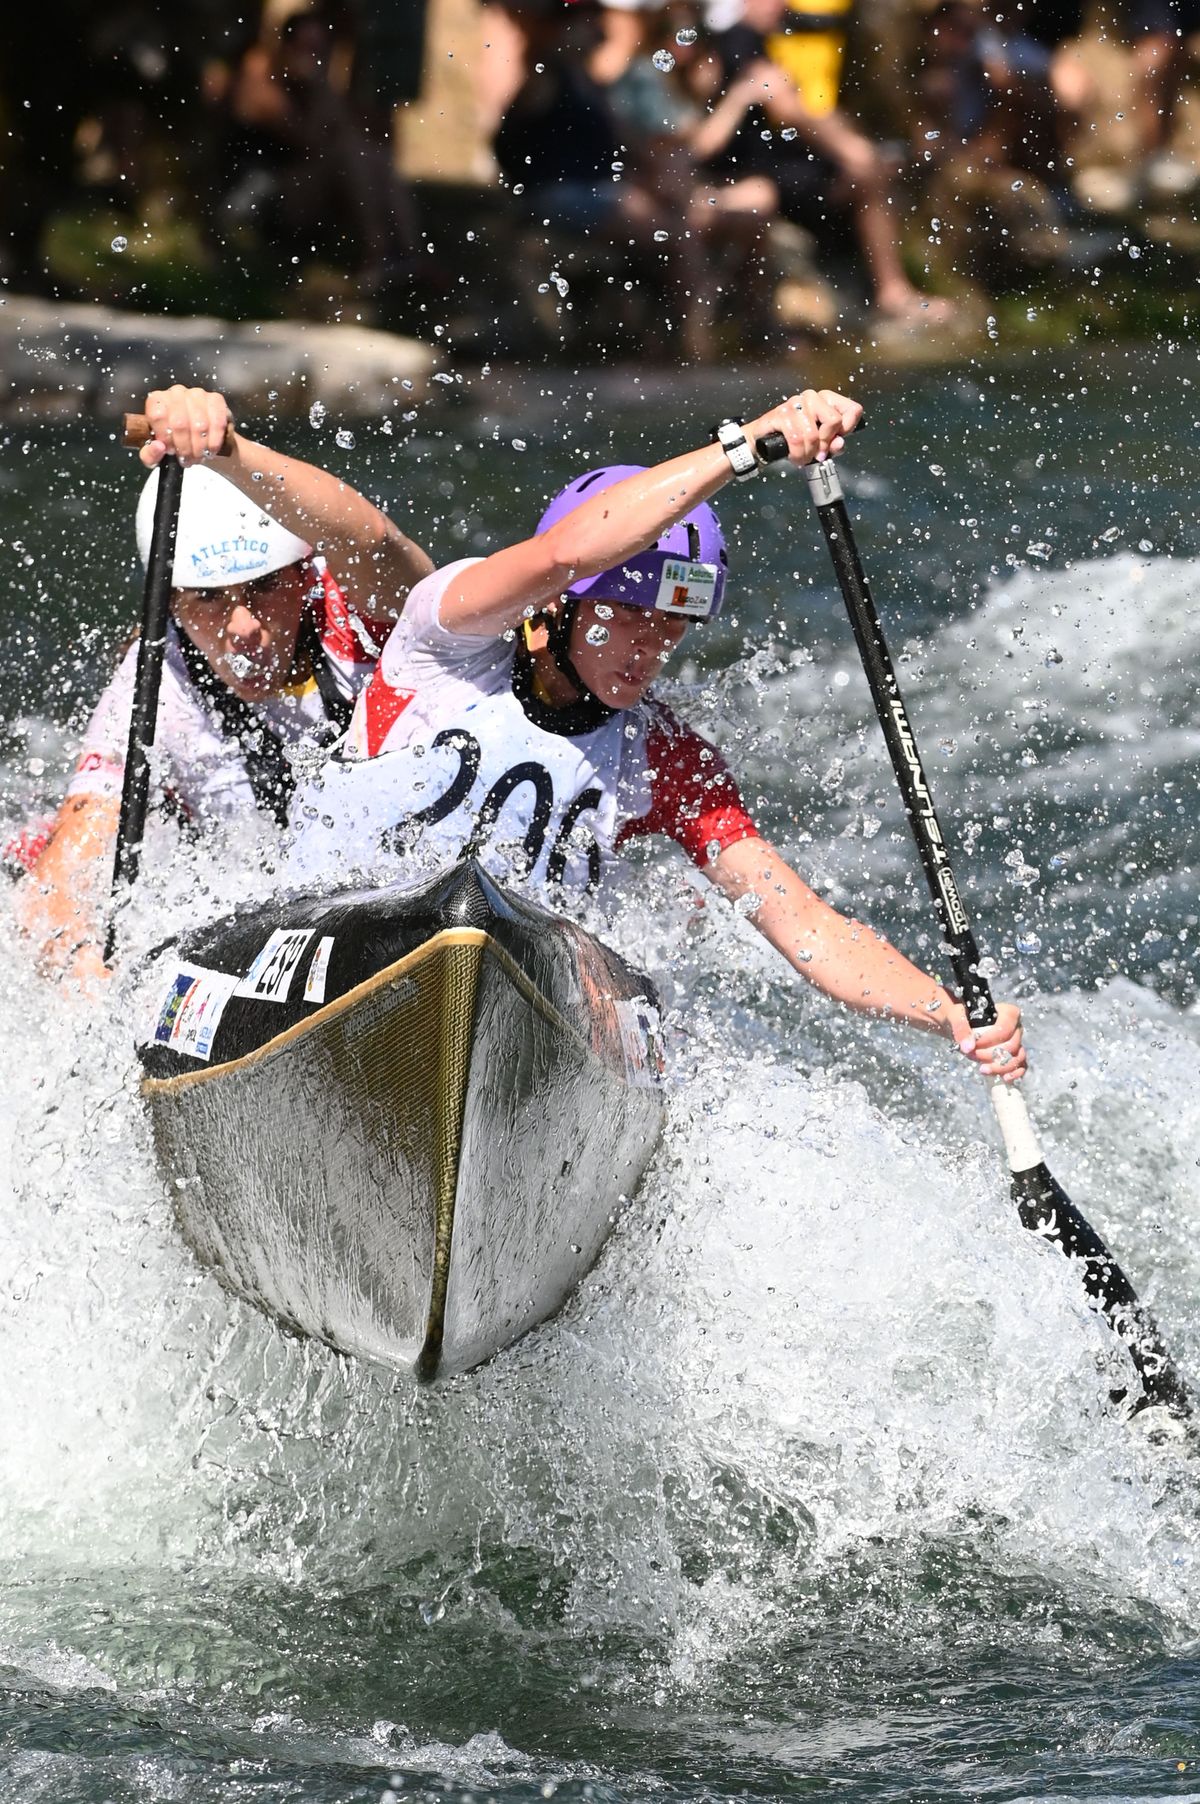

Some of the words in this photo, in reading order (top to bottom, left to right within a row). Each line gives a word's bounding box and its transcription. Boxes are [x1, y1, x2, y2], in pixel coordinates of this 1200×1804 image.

[191, 539, 269, 567] ATLETICO
[889, 699, 949, 865] TSUNAMI
[254, 934, 308, 996] ESP
